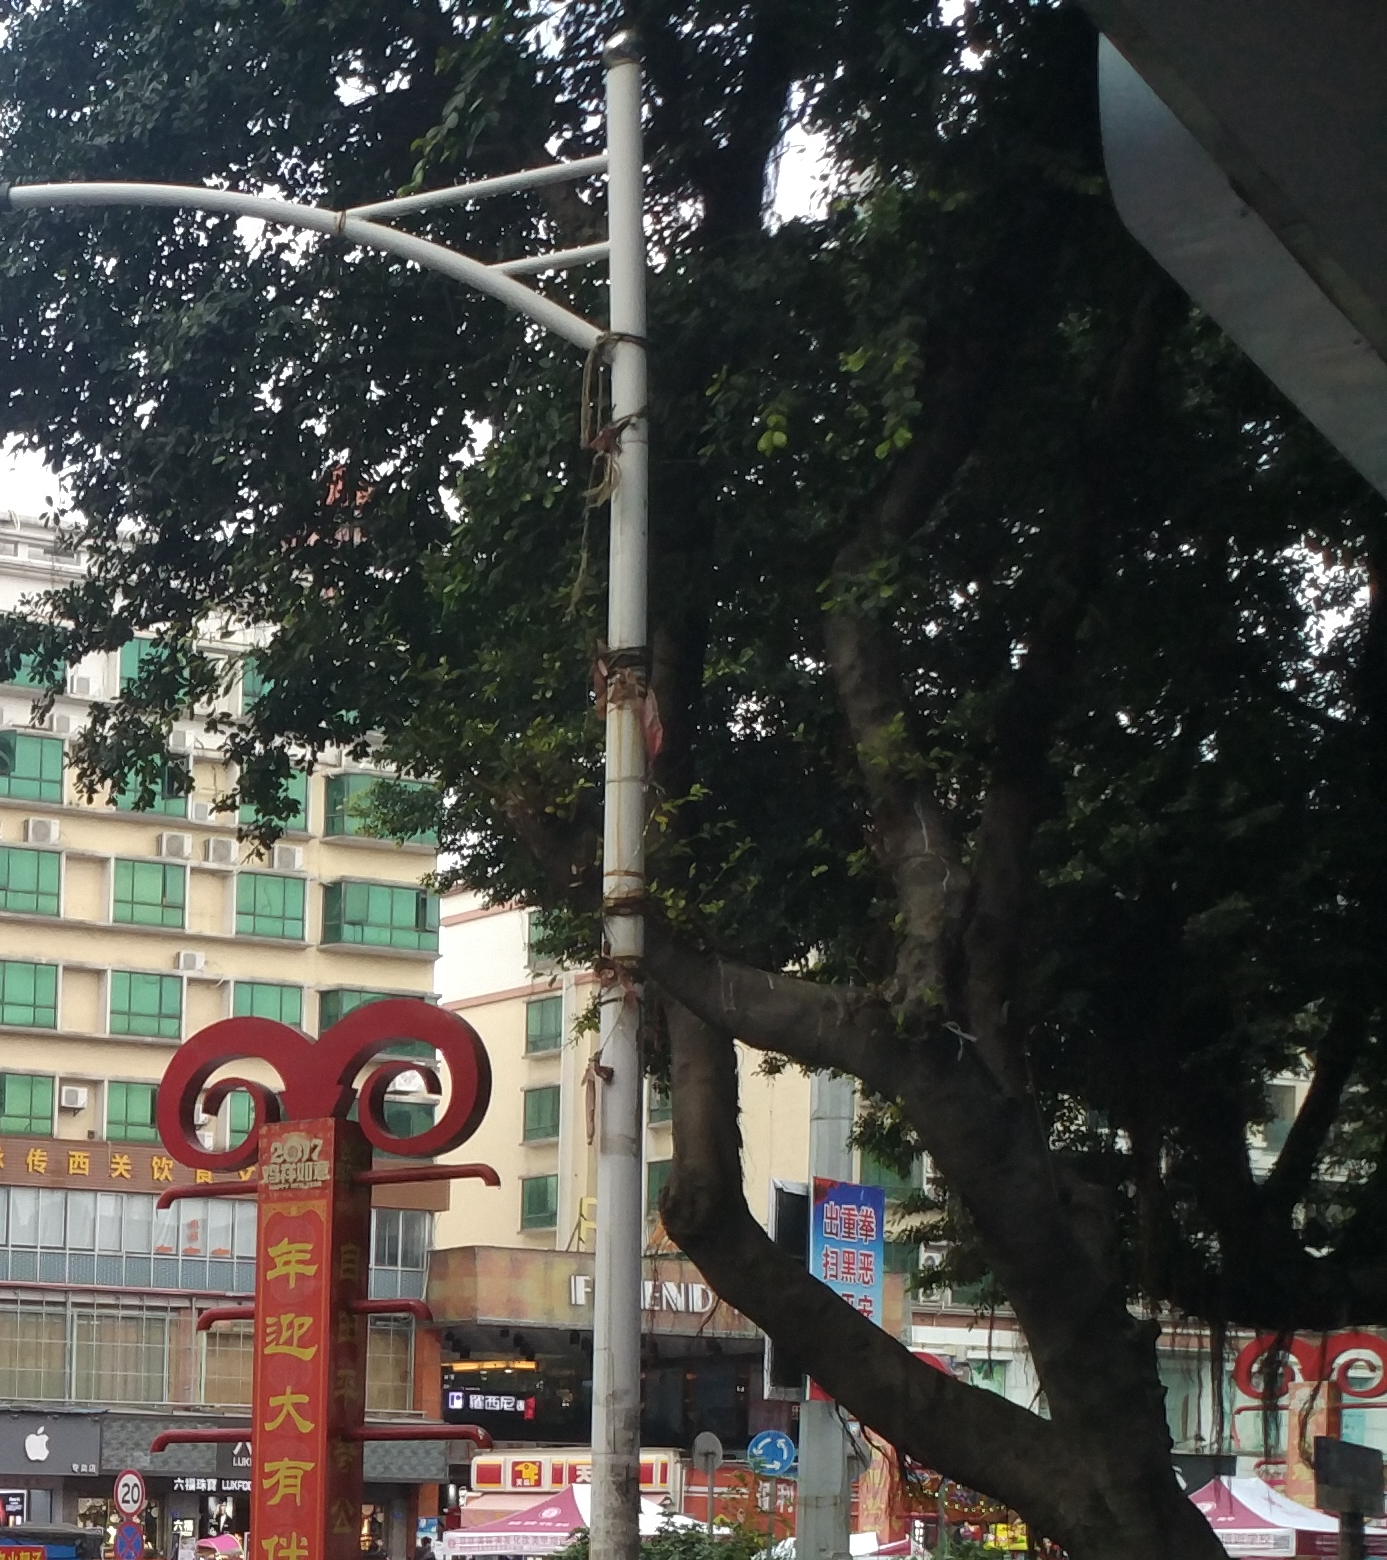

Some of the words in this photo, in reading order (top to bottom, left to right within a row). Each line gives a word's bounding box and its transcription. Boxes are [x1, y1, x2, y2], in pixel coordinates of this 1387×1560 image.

[270, 1138, 324, 1163] 2017
[822, 1201, 876, 1245] 出重拳
[822, 1244, 875, 1286] 扫黑恶
[570, 1274, 715, 1313] FEND
[121, 1482, 140, 1505] 20
